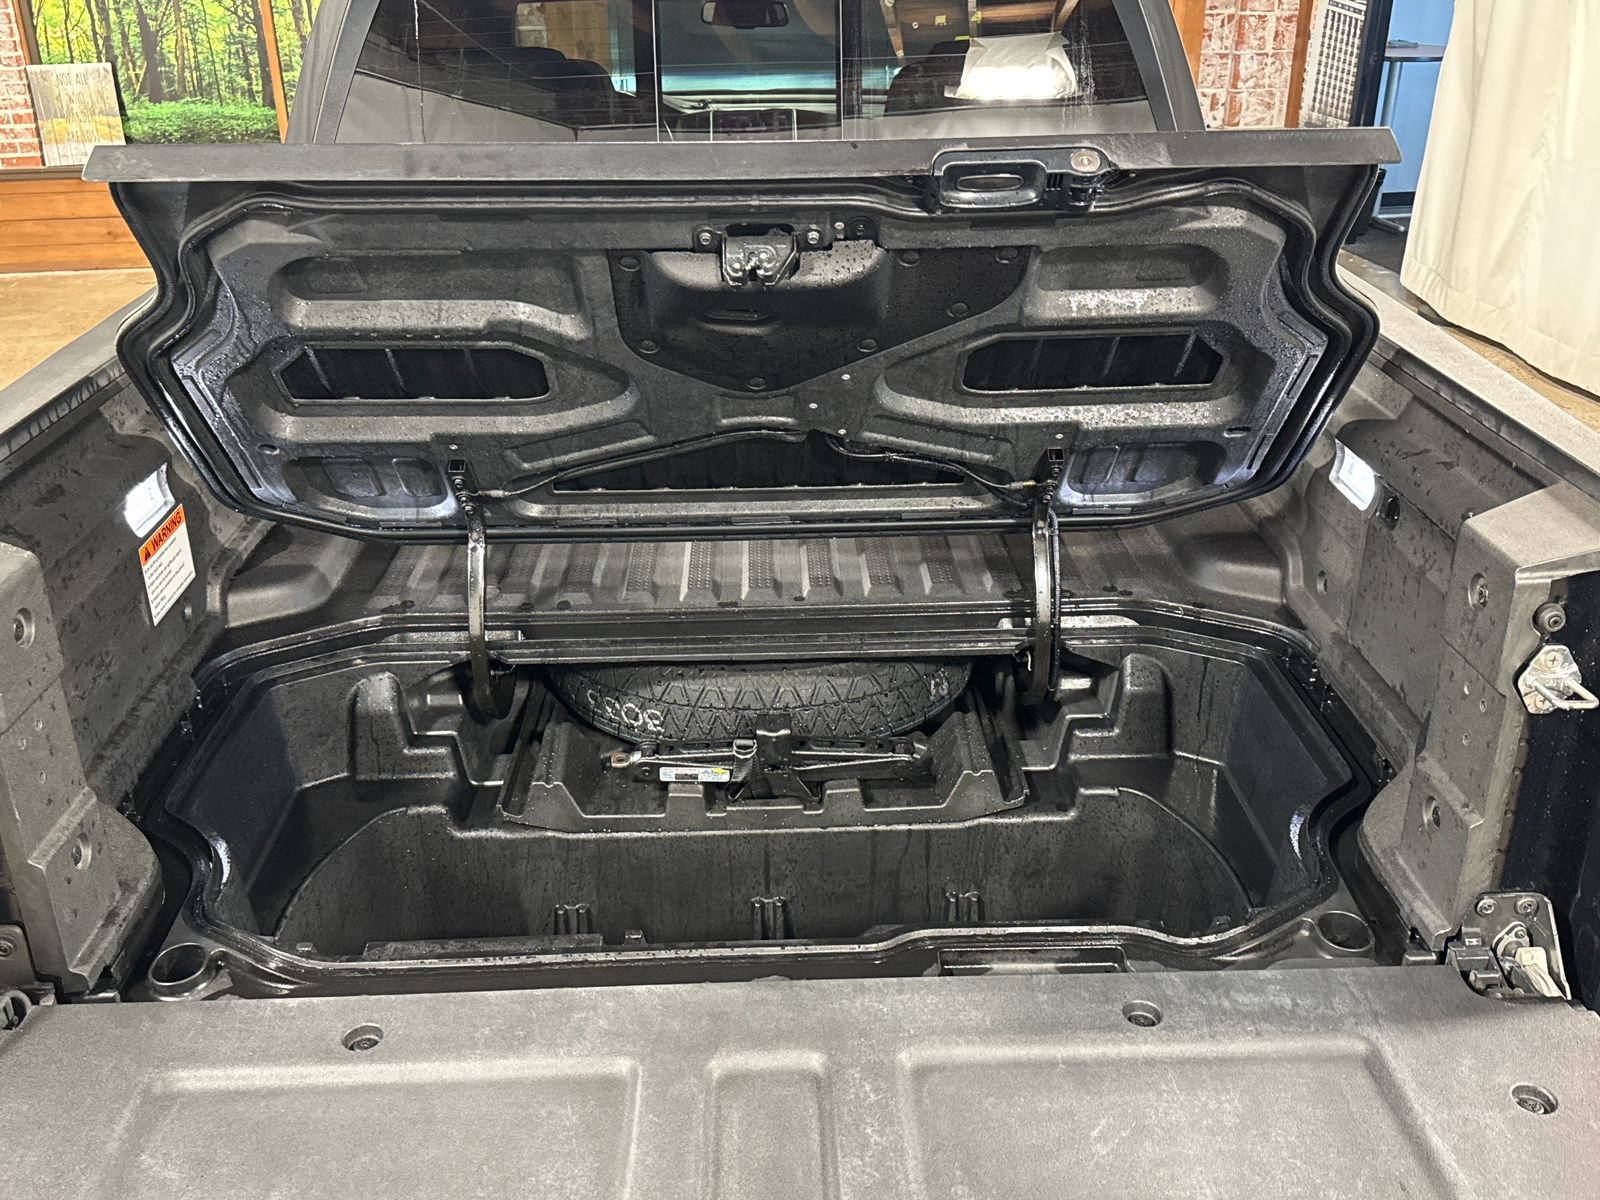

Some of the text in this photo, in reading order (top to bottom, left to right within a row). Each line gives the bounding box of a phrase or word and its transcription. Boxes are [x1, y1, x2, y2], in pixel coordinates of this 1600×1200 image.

[56, 72, 89, 86] NOT ALL
[67, 130, 80, 143] ARE
[151, 511, 182, 552] WARNING
